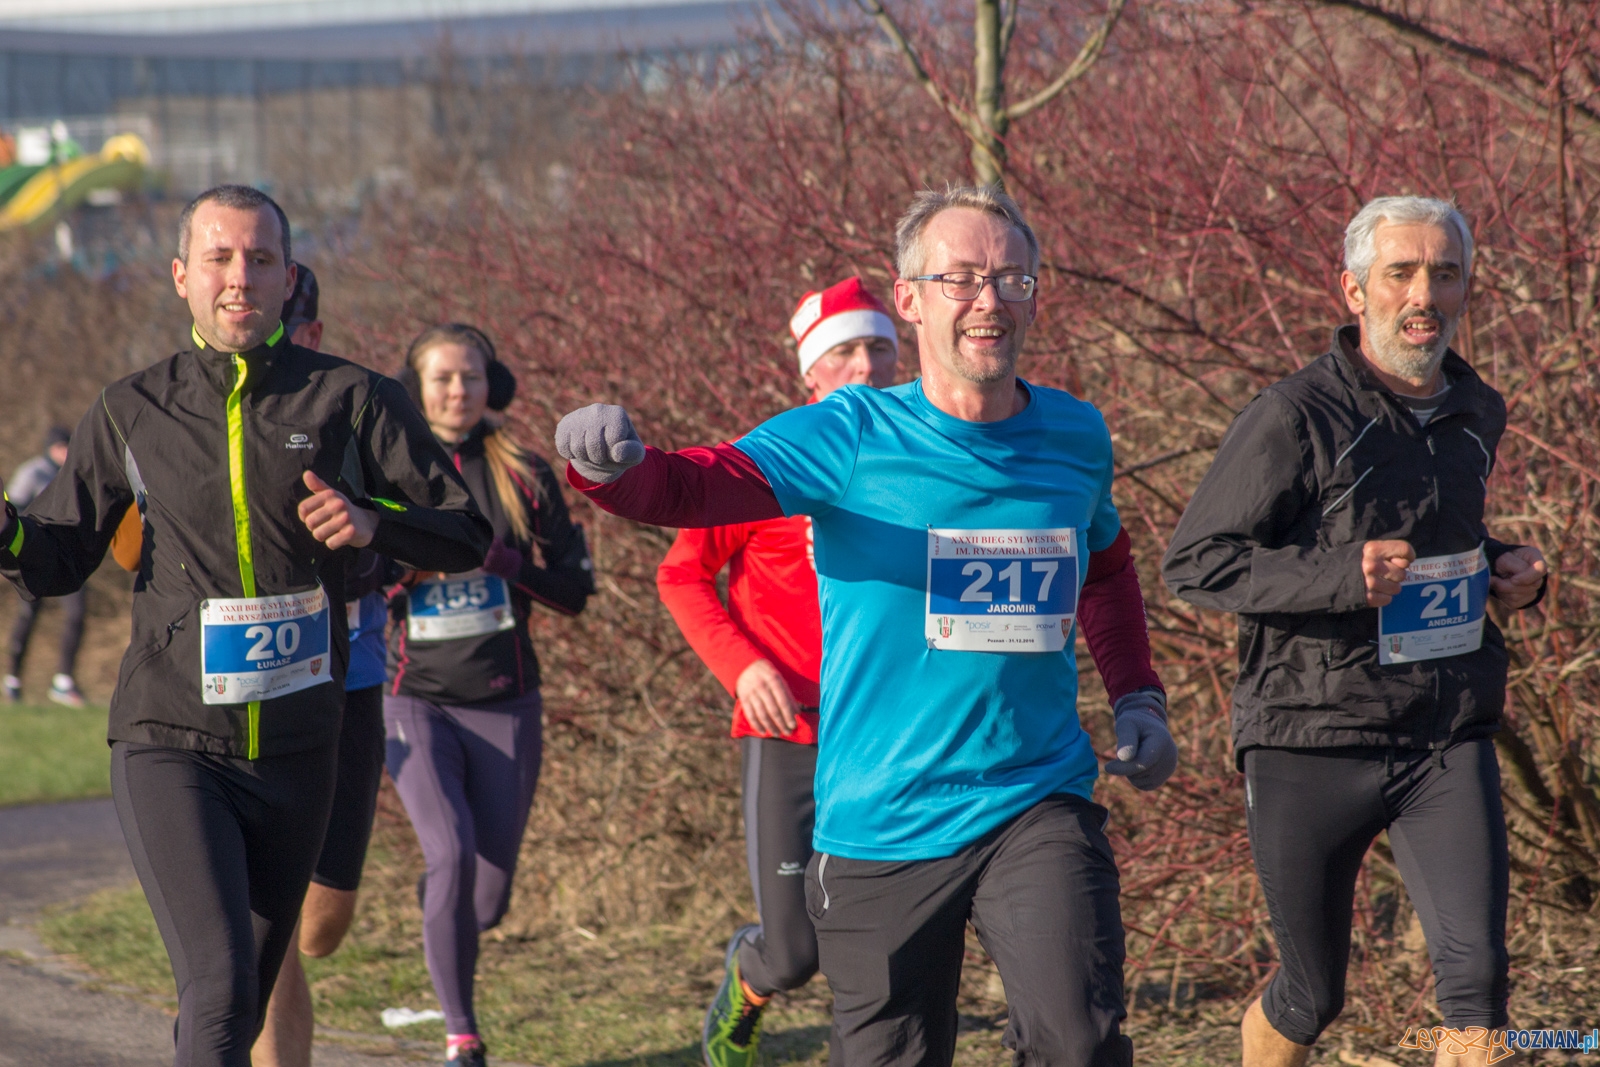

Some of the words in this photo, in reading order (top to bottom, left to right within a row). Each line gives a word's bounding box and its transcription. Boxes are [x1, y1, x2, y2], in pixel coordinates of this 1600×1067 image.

[951, 536, 979, 544] XXXII
[981, 536, 1005, 544] BIEG
[955, 548, 970, 556] IM.
[973, 547, 1026, 556] RYSZARDA
[1421, 563, 1441, 571] BIEG
[1414, 570, 1458, 581] RYSZARDA
[960, 561, 1059, 602] 217
[425, 579, 490, 610] 455
[1420, 579, 1469, 619] 21
[219, 605, 244, 613] XXXII
[245, 604, 267, 612] BIEG
[987, 604, 1036, 613] JAROMIR
[223, 614, 237, 622] IM.
[238, 611, 286, 621] RYSZARDA
[1427, 615, 1468, 628] ANDRZEJ
[245, 621, 301, 661] 20
[256, 656, 292, 670] ŁUKASZ
